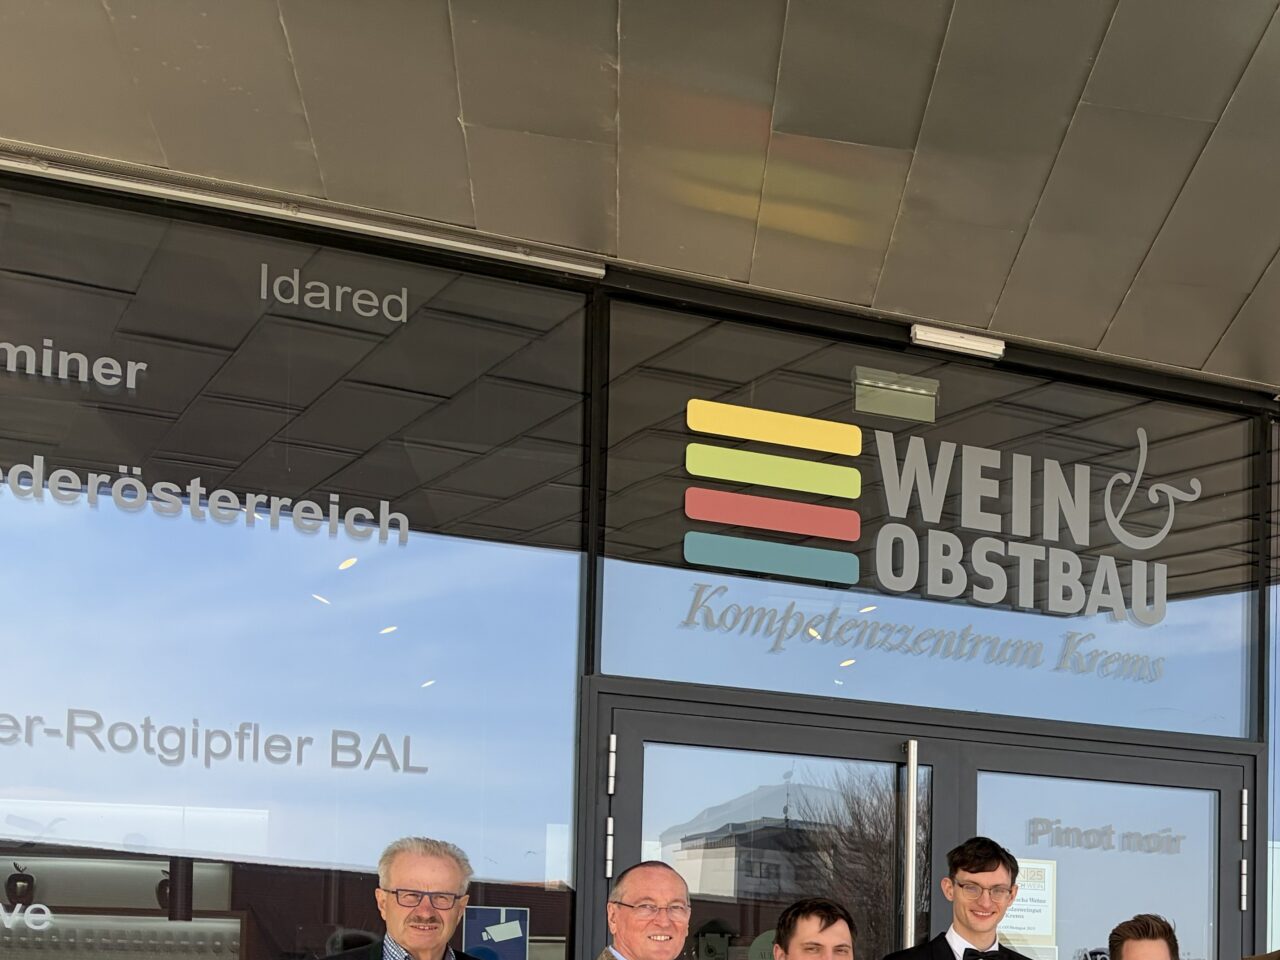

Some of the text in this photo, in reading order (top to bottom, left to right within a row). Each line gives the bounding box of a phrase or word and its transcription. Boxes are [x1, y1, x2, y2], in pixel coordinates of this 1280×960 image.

[260, 263, 408, 323] Idared
[0, 455, 409, 543] derösterreich
[875, 427, 1201, 550] WEIN &
[876, 523, 1167, 626] OBSTBAU
[680, 582, 1166, 683] Kompetenzzentrum Krems
[331, 731, 428, 774] BAL
[1029, 817, 1185, 854] Pinot noir
